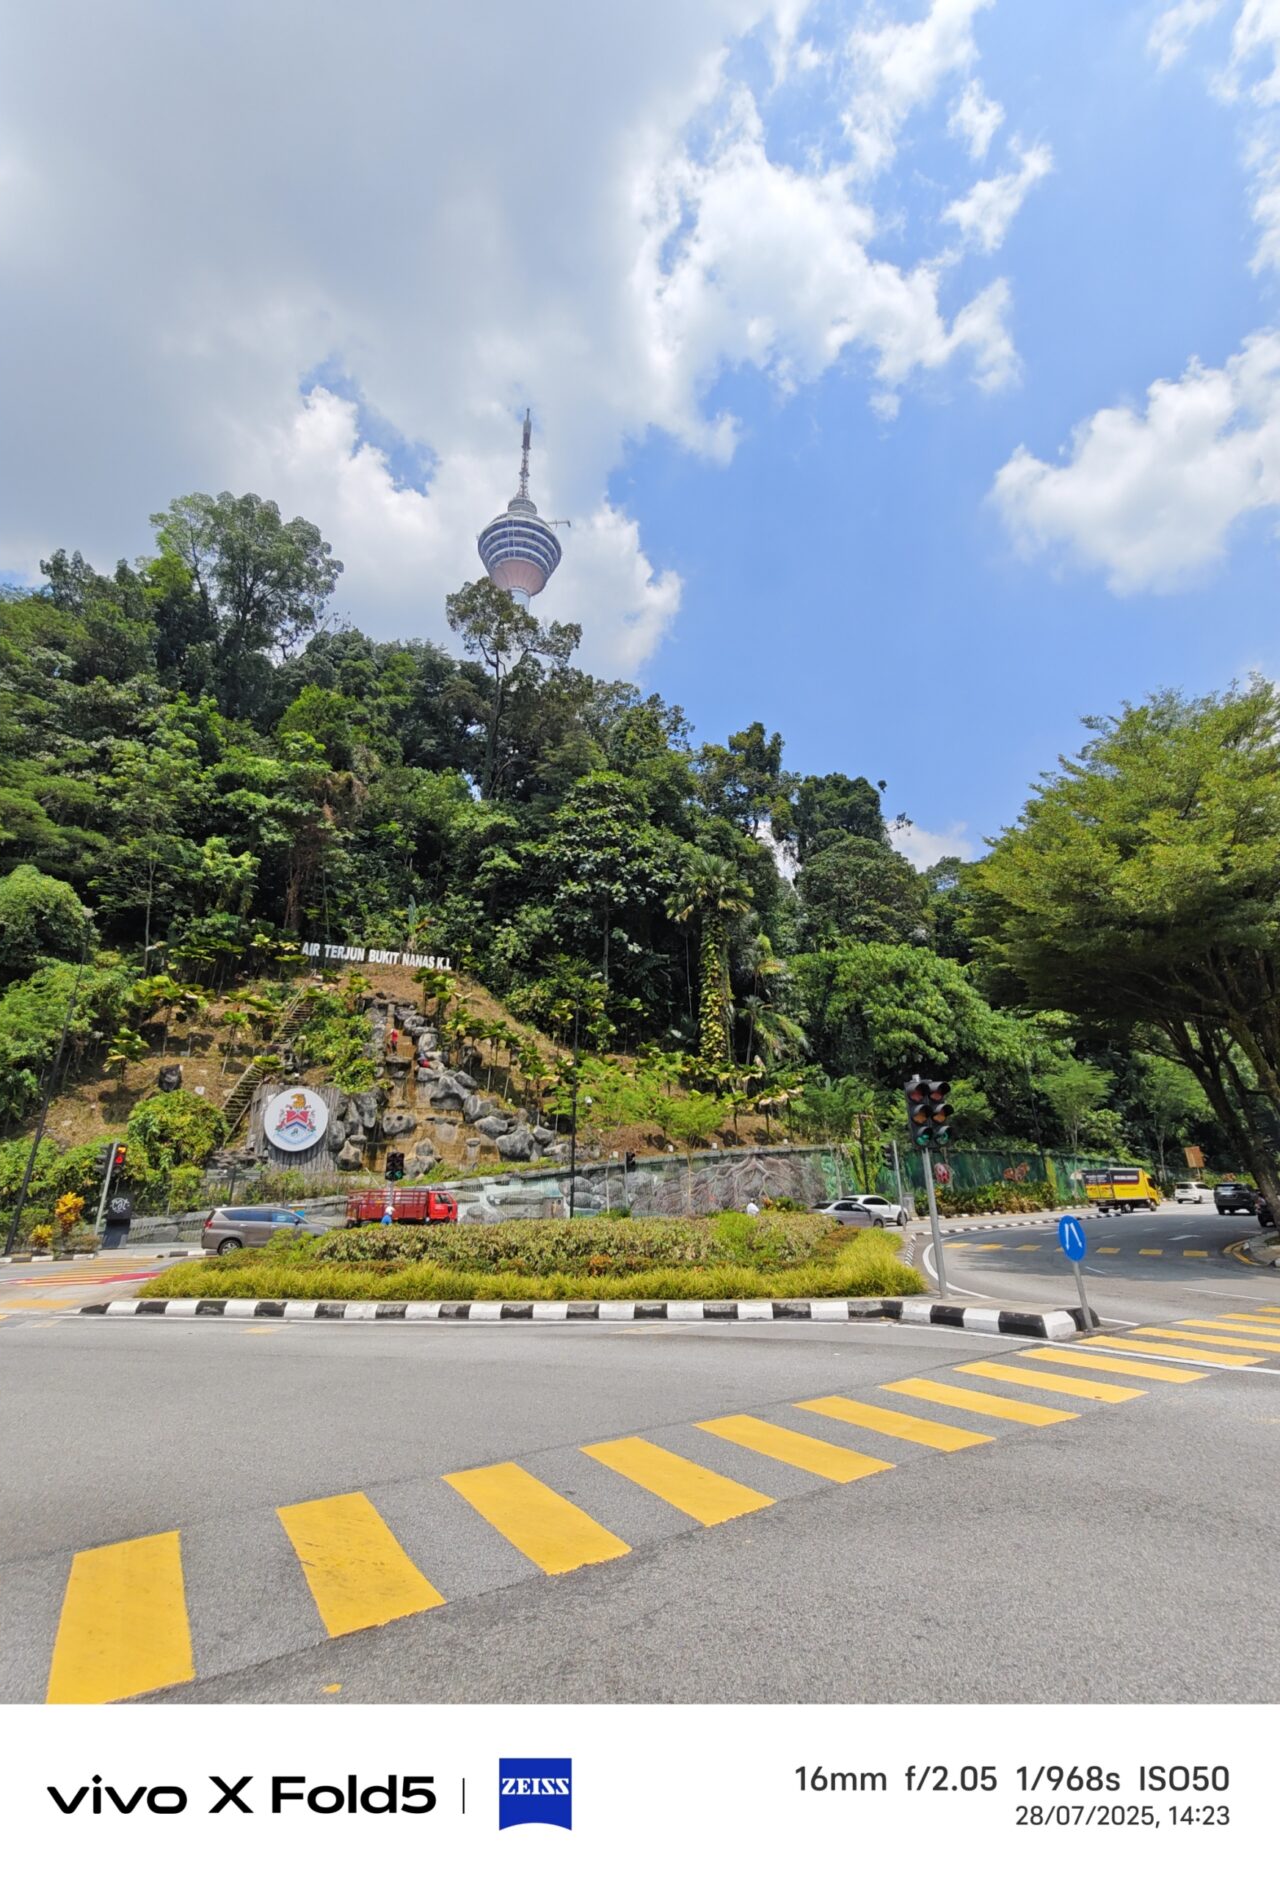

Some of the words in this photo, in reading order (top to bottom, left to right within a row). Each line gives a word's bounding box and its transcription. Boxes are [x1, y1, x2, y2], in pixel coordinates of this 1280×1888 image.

[301, 942, 320, 957] AIR
[324, 944, 366, 961] TERJUN
[368, 949, 400, 965] BUKIT
[402, 952, 436, 968] NANAS
